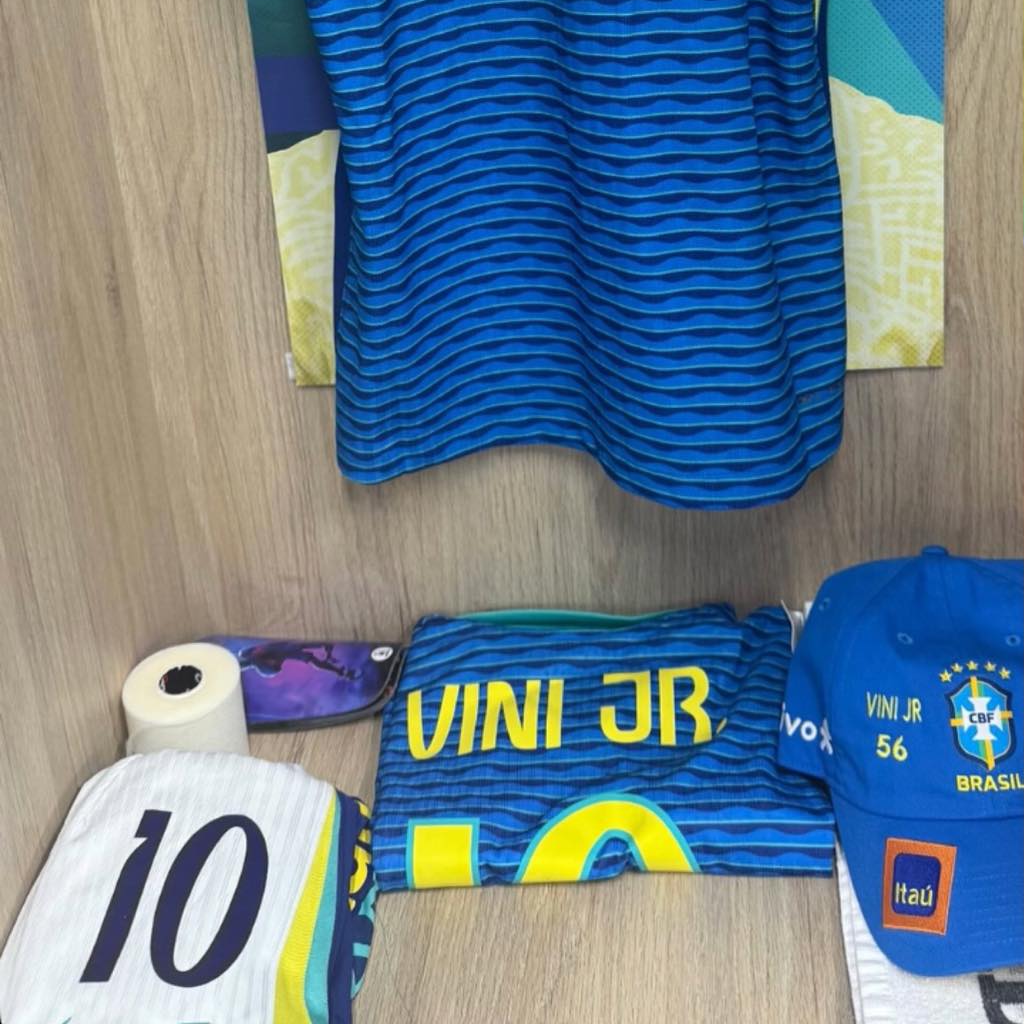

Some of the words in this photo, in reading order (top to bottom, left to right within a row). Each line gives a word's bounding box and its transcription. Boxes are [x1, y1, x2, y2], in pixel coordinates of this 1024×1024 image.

[407, 679, 564, 760] VINI
[866, 691, 898, 721] VINI
[902, 697, 922, 723] JR
[969, 712, 994, 724] CBF
[876, 733, 908, 762] 56
[956, 773, 1024, 792] BRASIL
[79, 809, 269, 988] 10
[895, 882, 933, 907] Itaú
